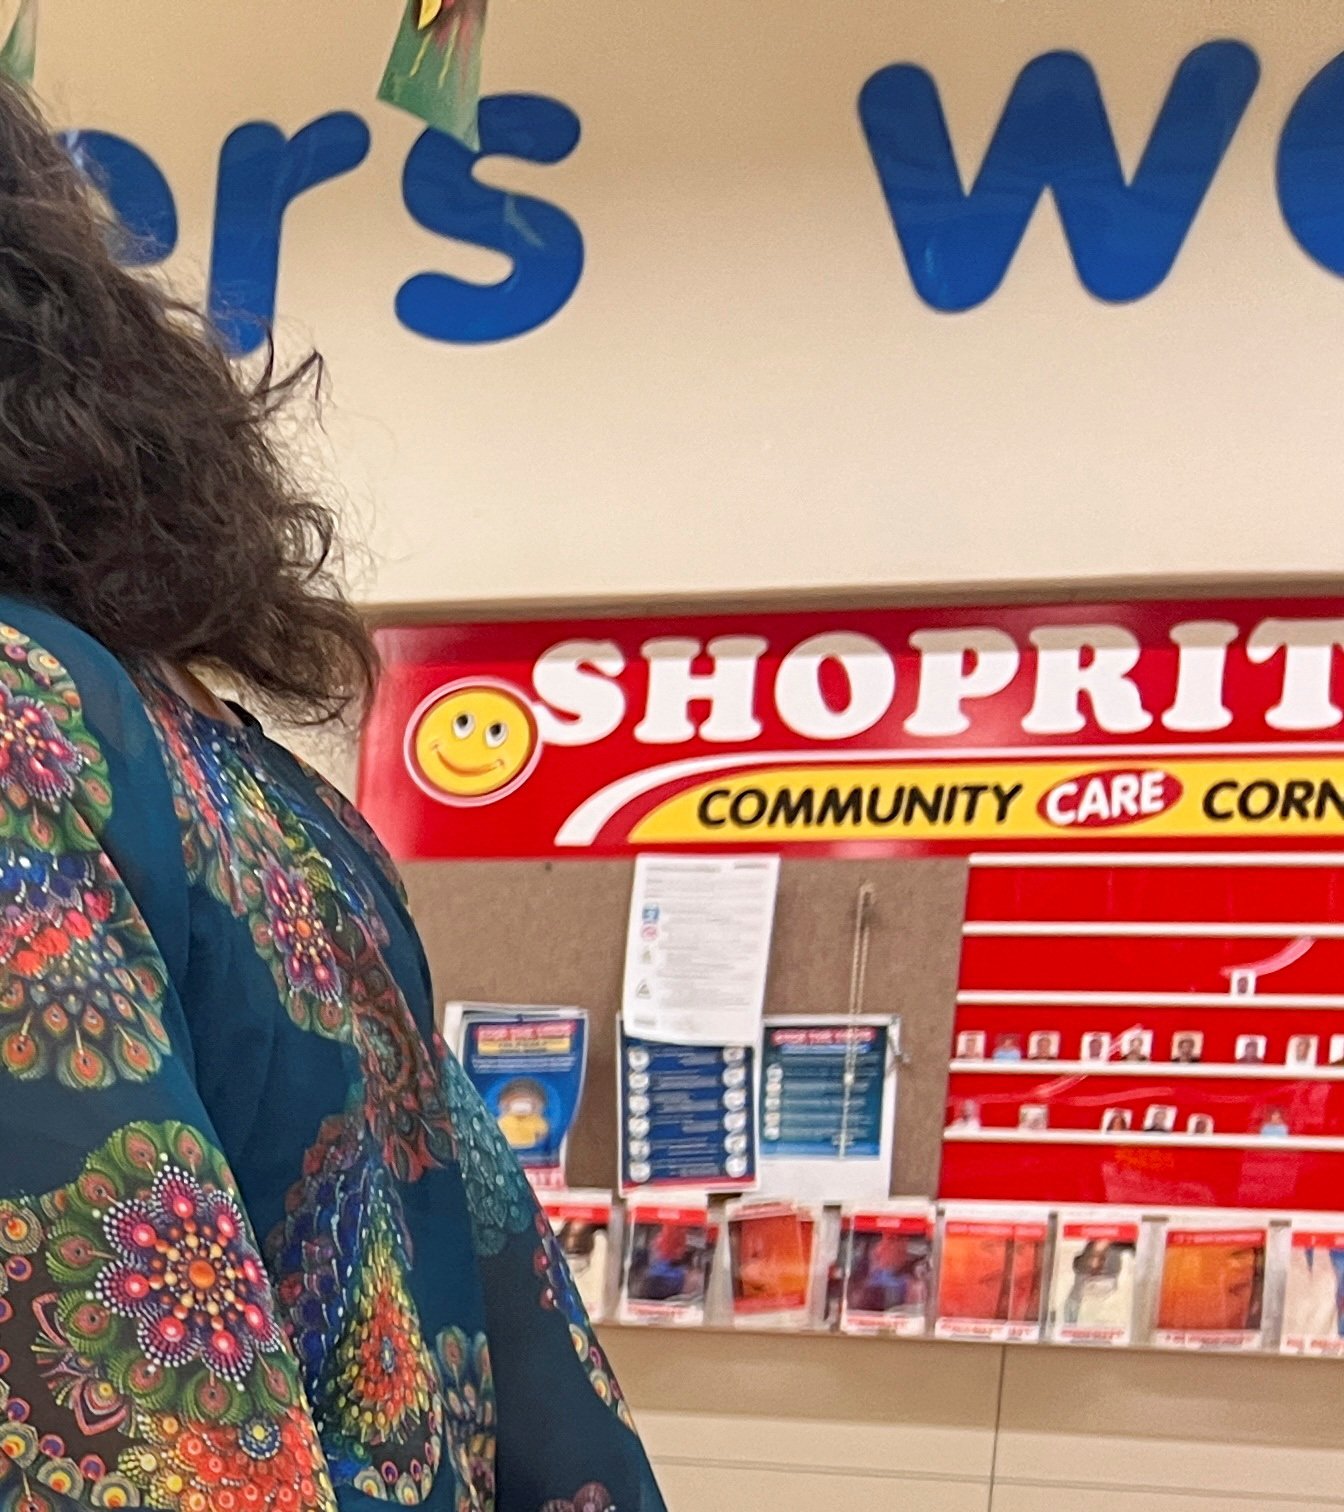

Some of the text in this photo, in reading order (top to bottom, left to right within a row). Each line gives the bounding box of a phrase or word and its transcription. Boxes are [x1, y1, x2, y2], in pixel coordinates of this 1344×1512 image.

[697, 770, 1344, 830] COMMUNITY CARE CORN
